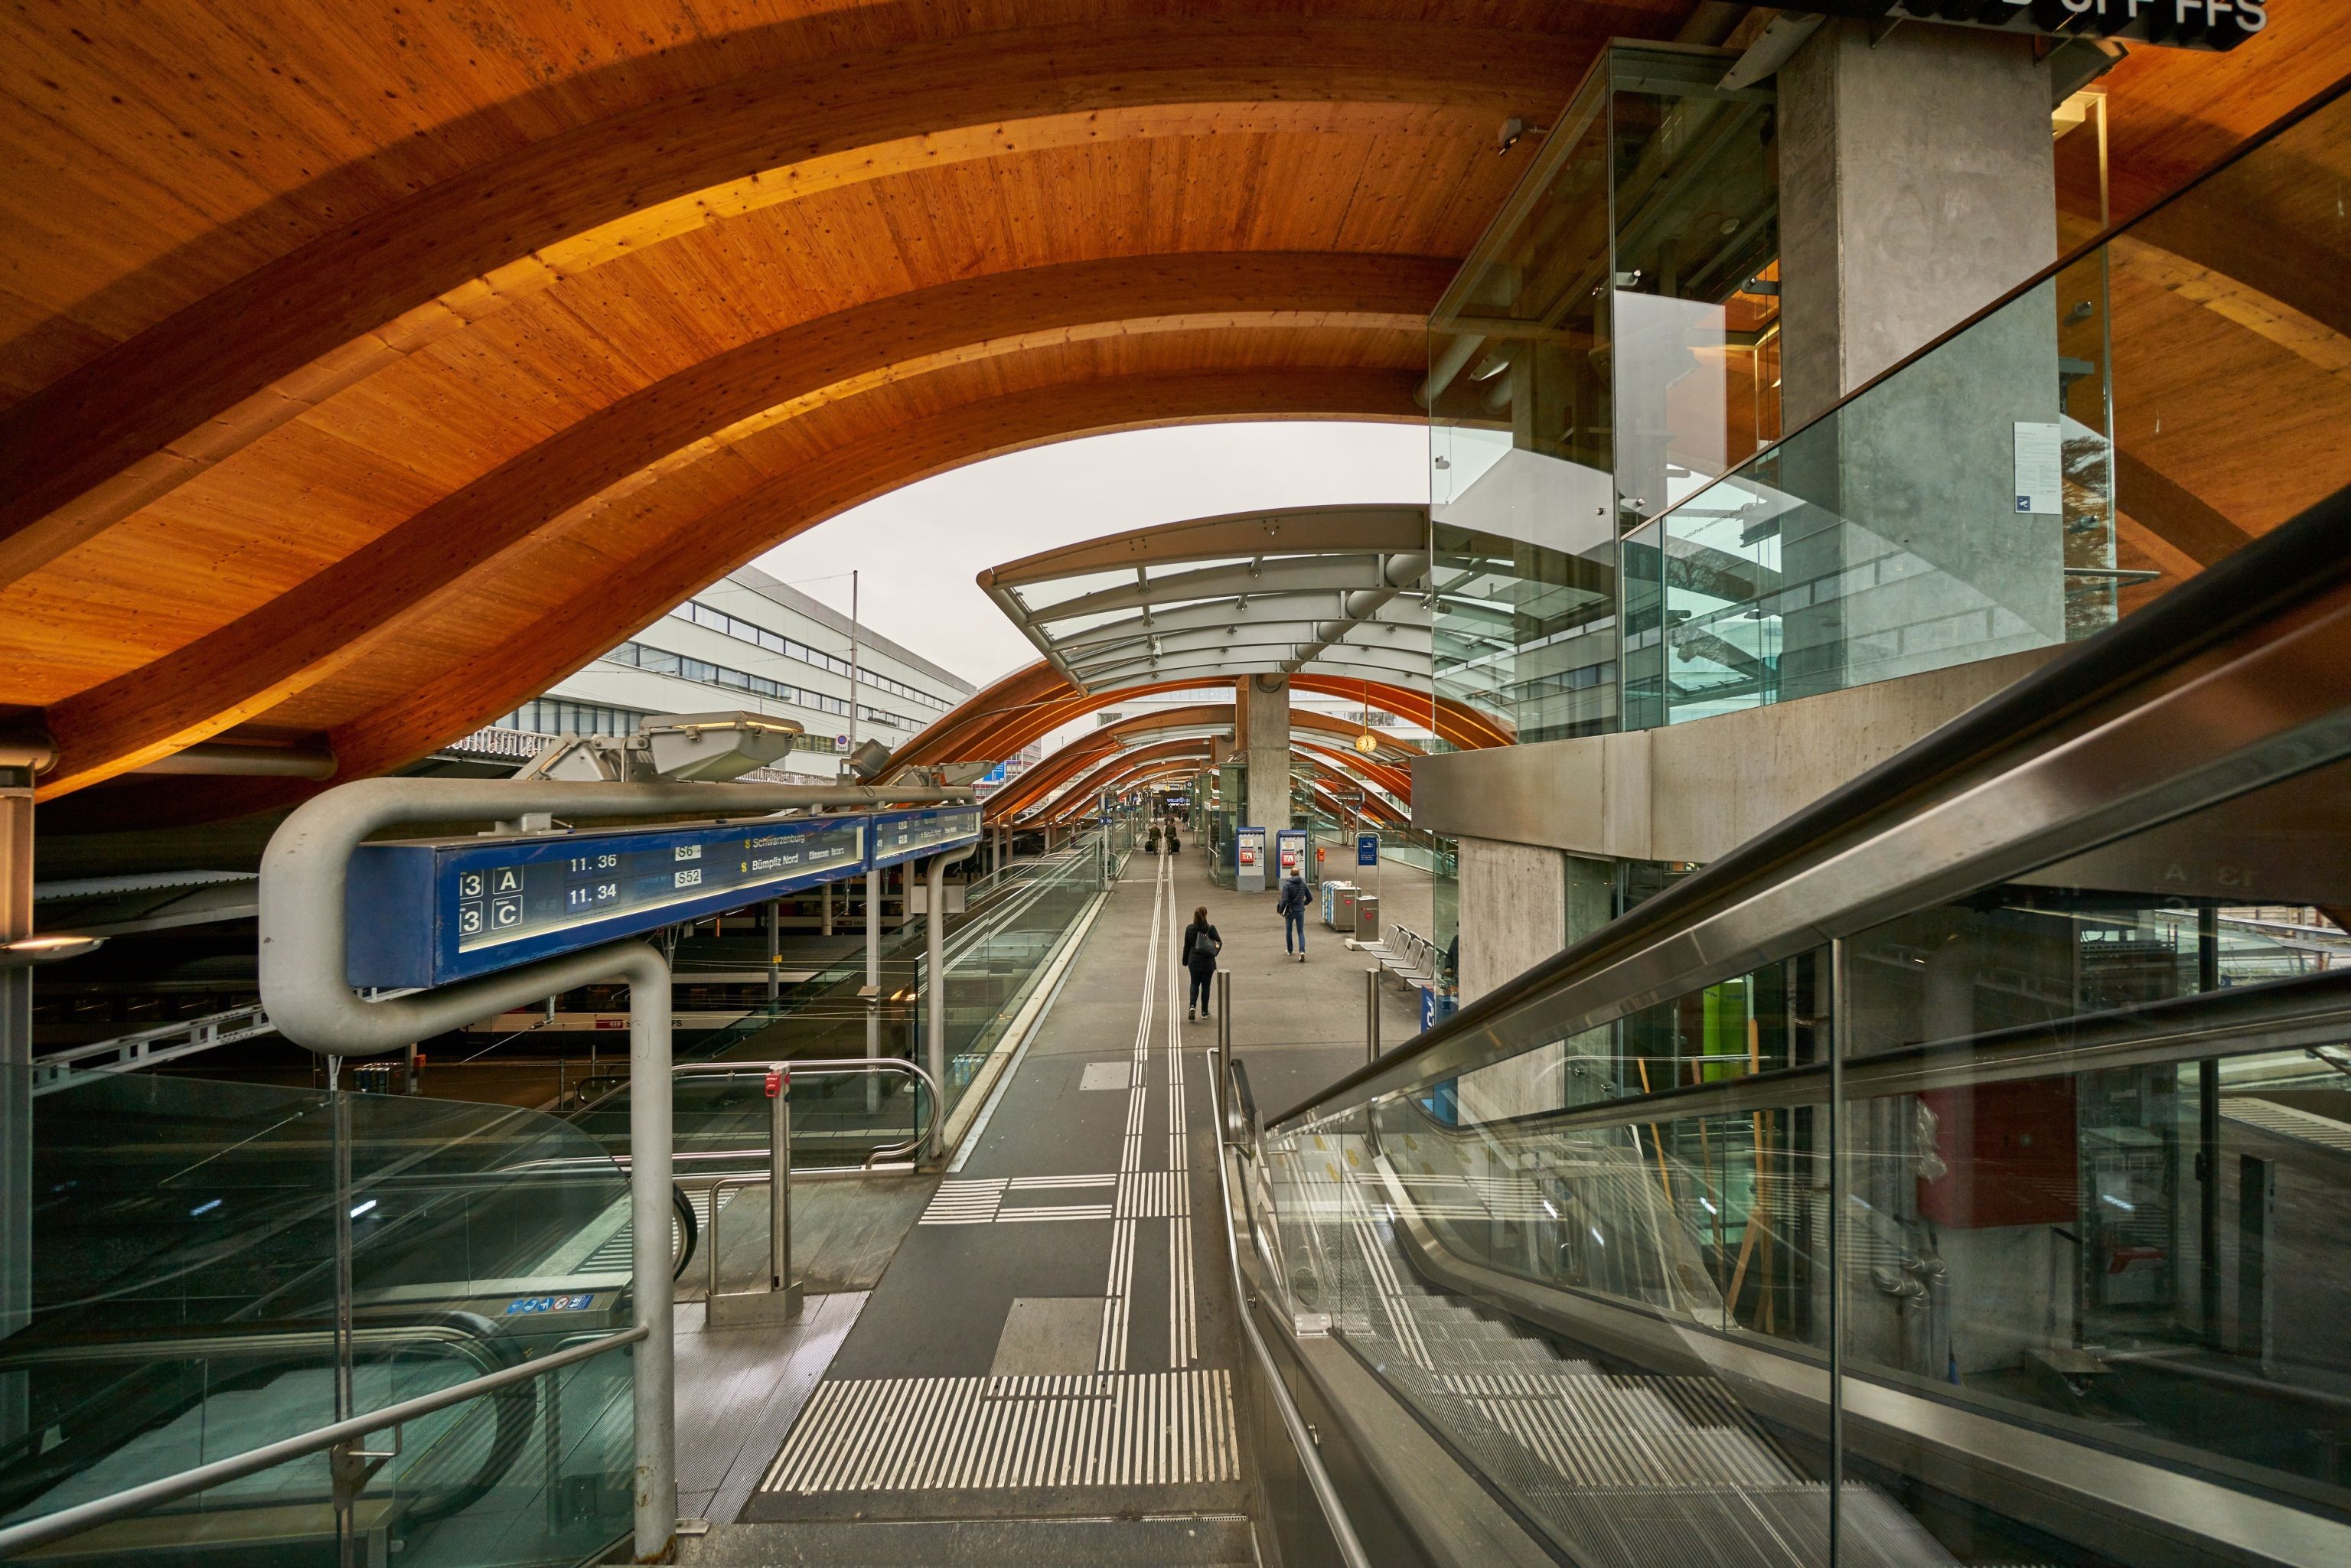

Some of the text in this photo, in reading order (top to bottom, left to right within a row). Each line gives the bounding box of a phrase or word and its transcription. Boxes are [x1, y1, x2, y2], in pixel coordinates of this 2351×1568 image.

[499, 905, 517, 924] C
[678, 870, 699, 884] S52
[752, 857, 782, 871] Bümpliz
[782, 853, 799, 865] Nord
[500, 872, 517, 890] A
[752, 834, 805, 849] Schwarzenburg
